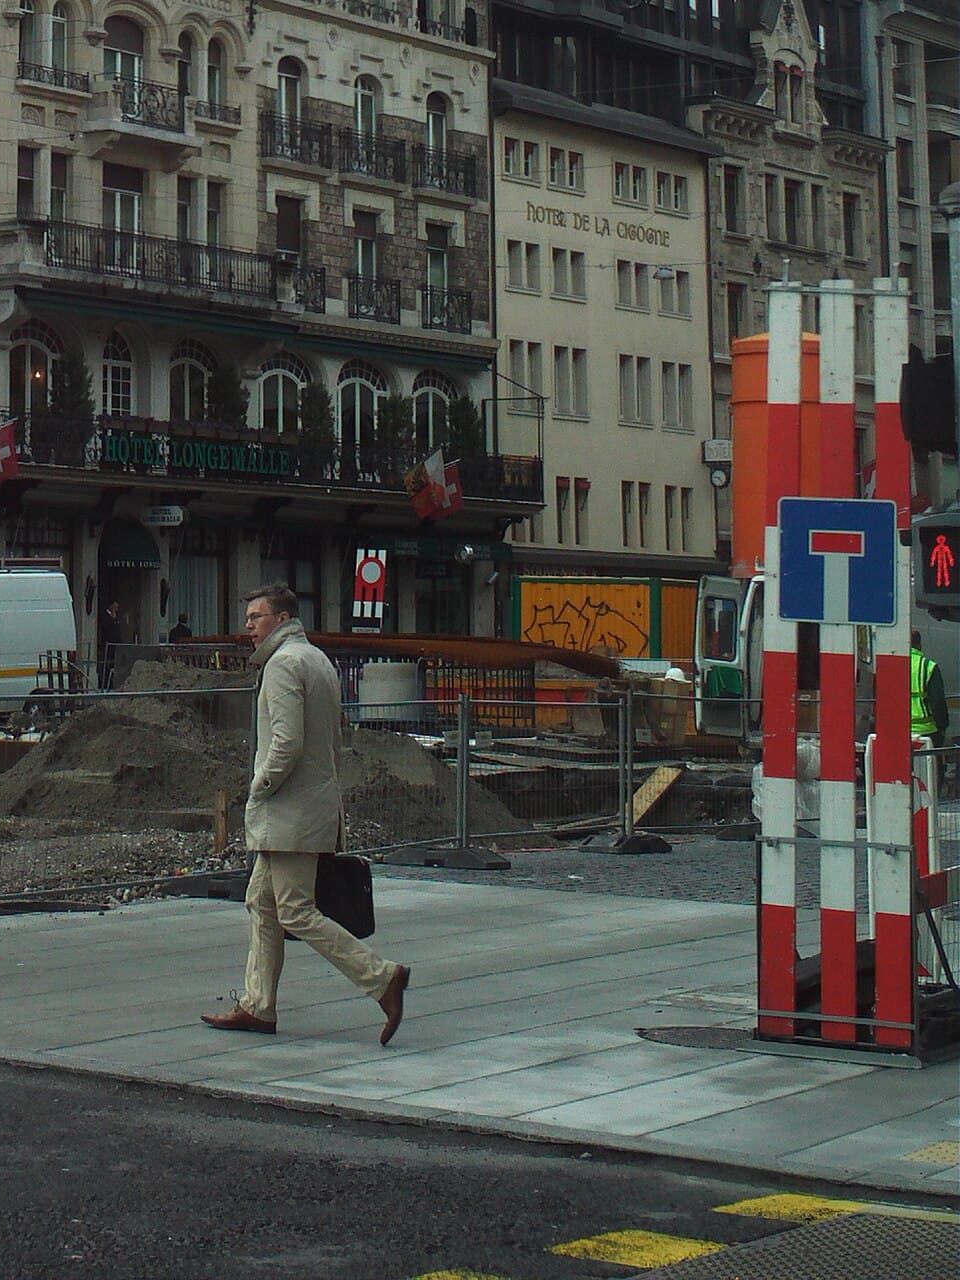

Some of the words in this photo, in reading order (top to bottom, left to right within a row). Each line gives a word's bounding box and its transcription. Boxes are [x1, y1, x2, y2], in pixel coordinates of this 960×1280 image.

[573, 212, 590, 232] DE
[595, 216, 611, 237] LA
[616, 221, 670, 247] CIGOGNE
[171, 440, 288, 474] LONGEMALLE
